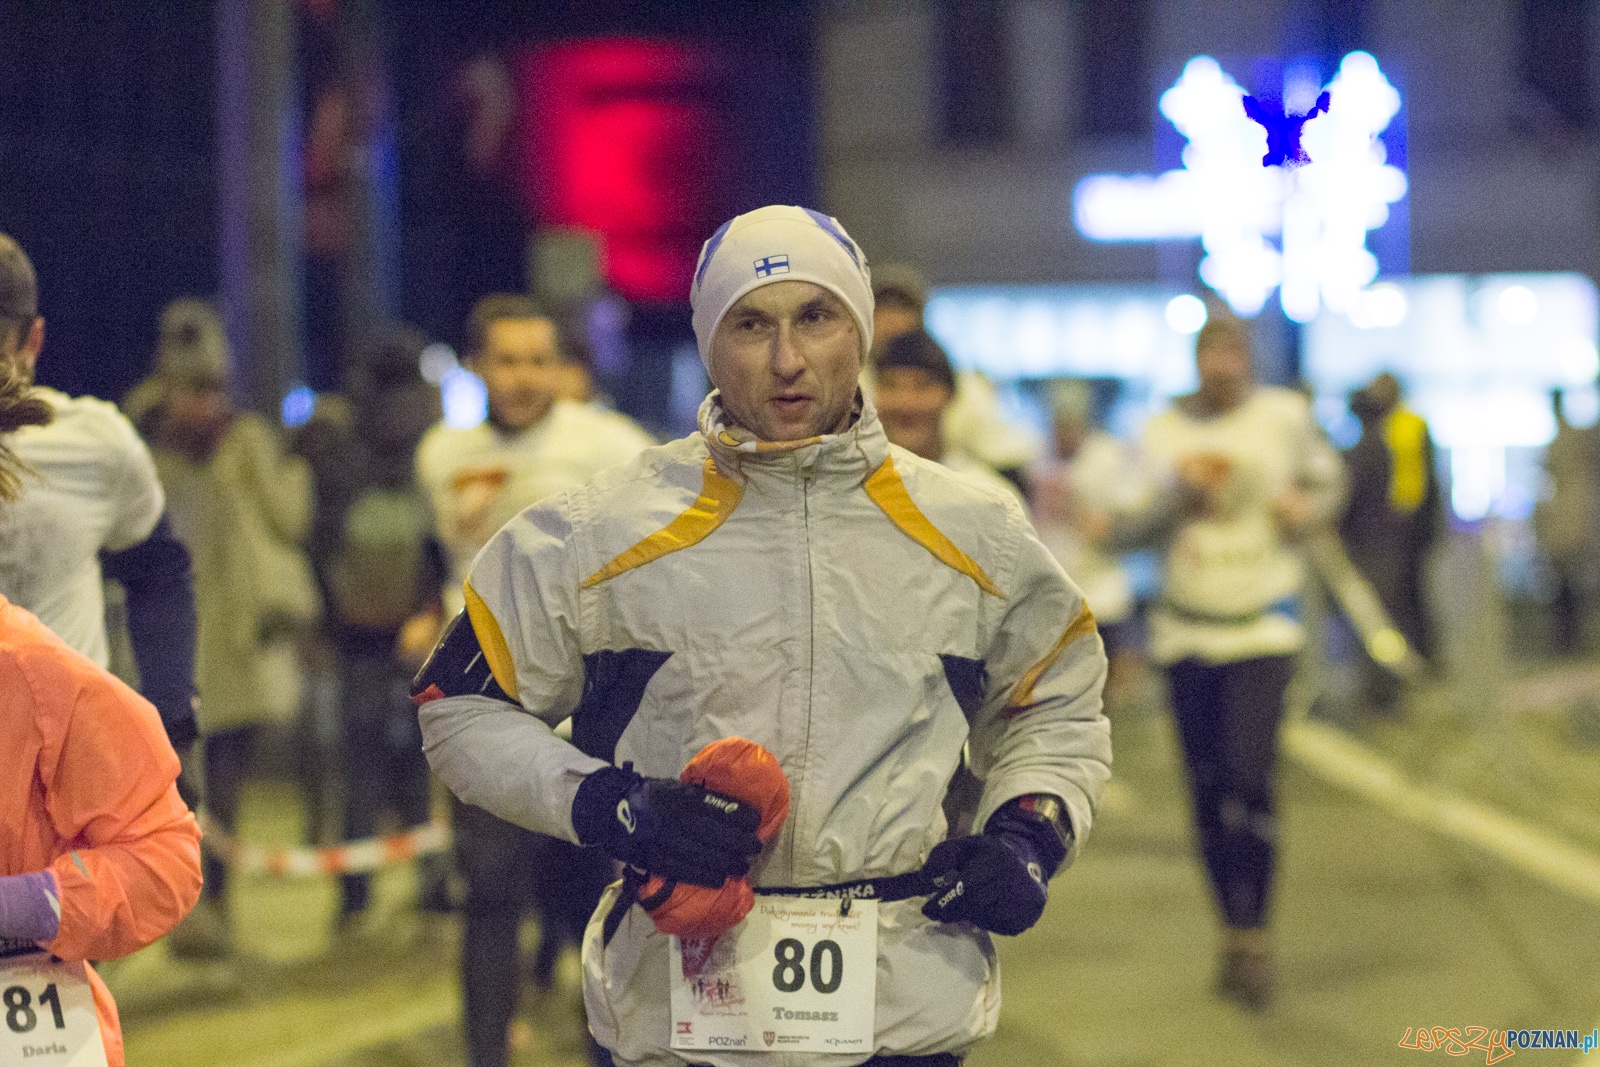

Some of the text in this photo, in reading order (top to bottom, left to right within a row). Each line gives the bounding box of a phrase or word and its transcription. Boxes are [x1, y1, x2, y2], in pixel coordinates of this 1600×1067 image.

[773, 938, 844, 994] 80
[3, 983, 66, 1034] 81
[773, 1007, 839, 1022] Tomasz
[22, 1043, 68, 1058] Daria
